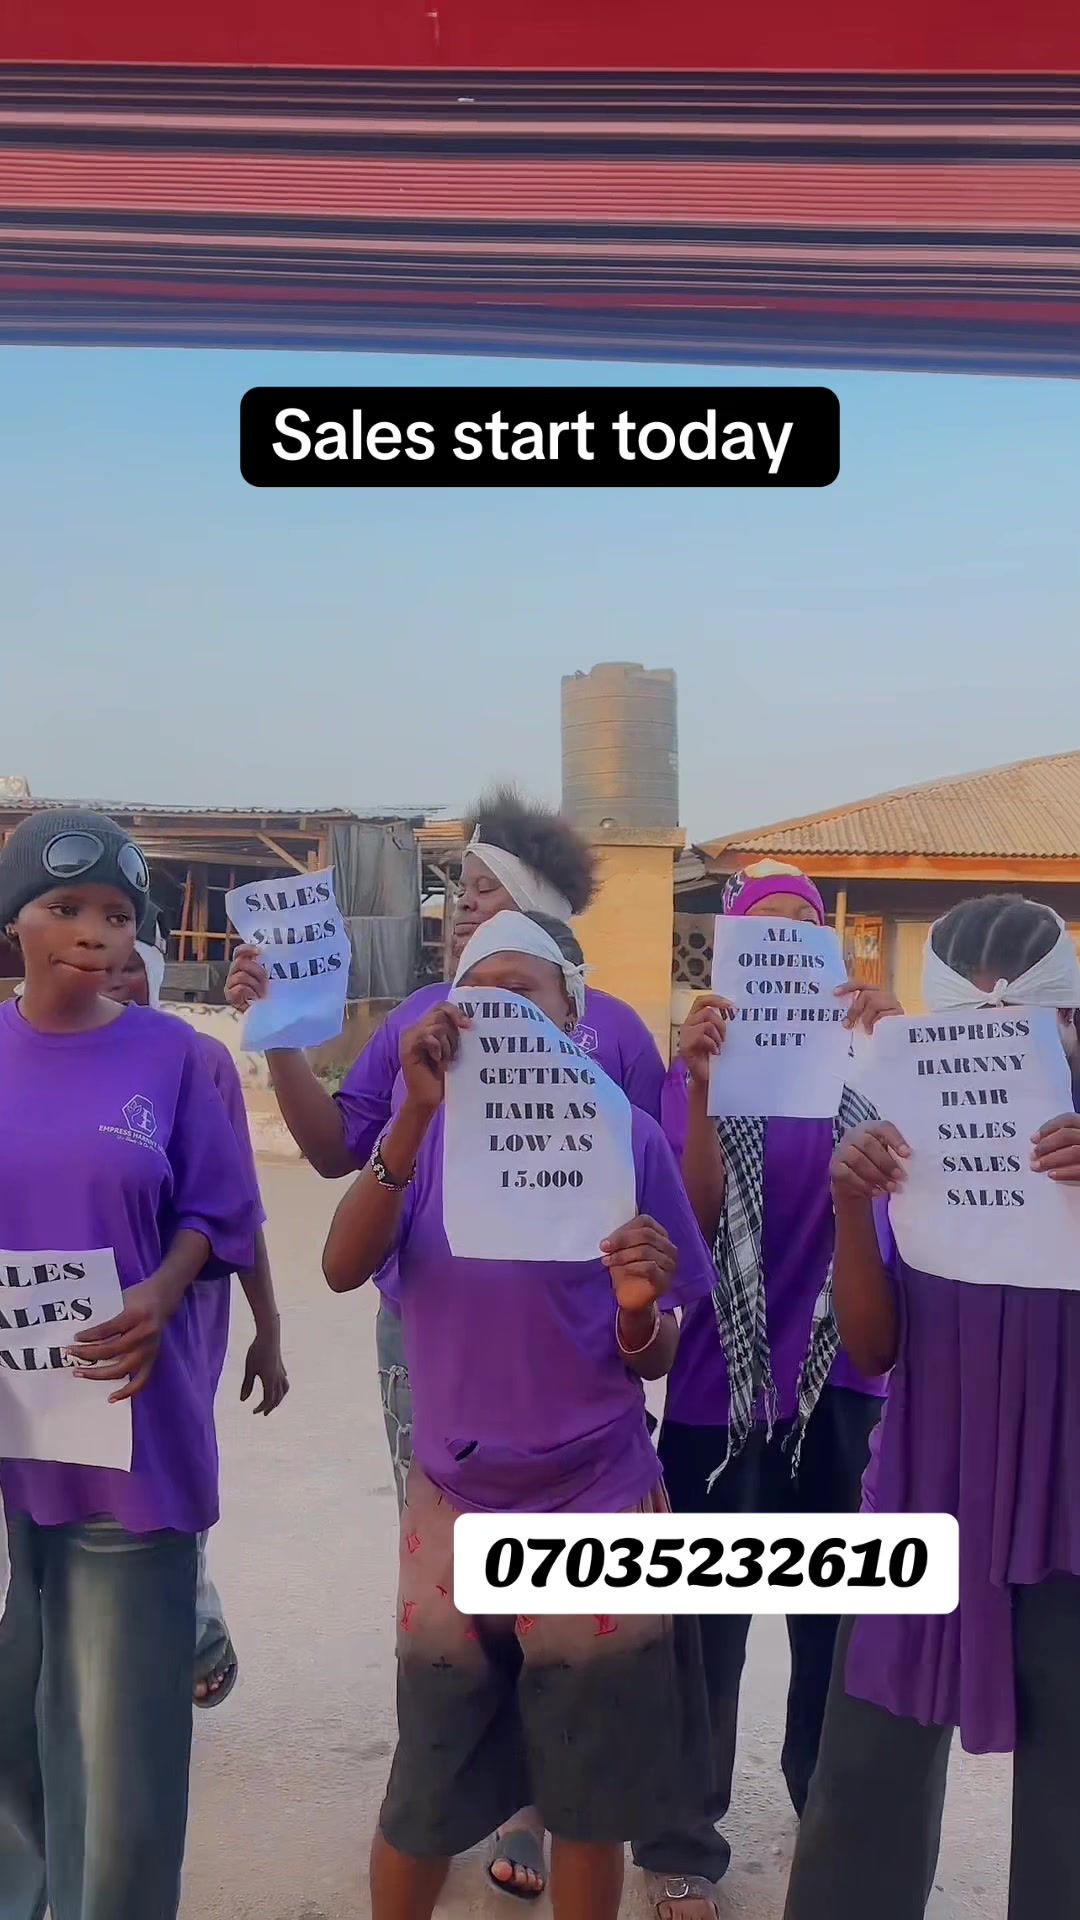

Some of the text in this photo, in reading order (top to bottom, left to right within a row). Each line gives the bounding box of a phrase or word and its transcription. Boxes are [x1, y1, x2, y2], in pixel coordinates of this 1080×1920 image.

[246, 882, 330, 912] SALES
[252, 919, 336, 944] SALES
[763, 928, 803, 942] ALL
[263, 953, 341, 980] ALES
[738, 953, 825, 968] ORDERS
[745, 980, 820, 995] COMES
[787, 1008, 845, 1022] FREE
[755, 1033, 806, 1047] GIFT
[909, 1020, 1030, 1043] EMPRESS
[479, 1036, 552, 1054] WILL
[917, 1054, 1026, 1076] HARNNY
[479, 1068, 596, 1085] GETTING
[941, 1089, 1008, 1106] HAIR
[485, 1101, 597, 1120] HAIR AS
[938, 1121, 1017, 1140] SALES
[489, 1134, 593, 1153] LOW AS
[942, 1155, 1022, 1173] SALES
[500, 1169, 584, 1190] 15,000
[947, 1189, 1025, 1207] SALES
[0, 1262, 86, 1288] LES
[0, 1297, 93, 1330] ALES
